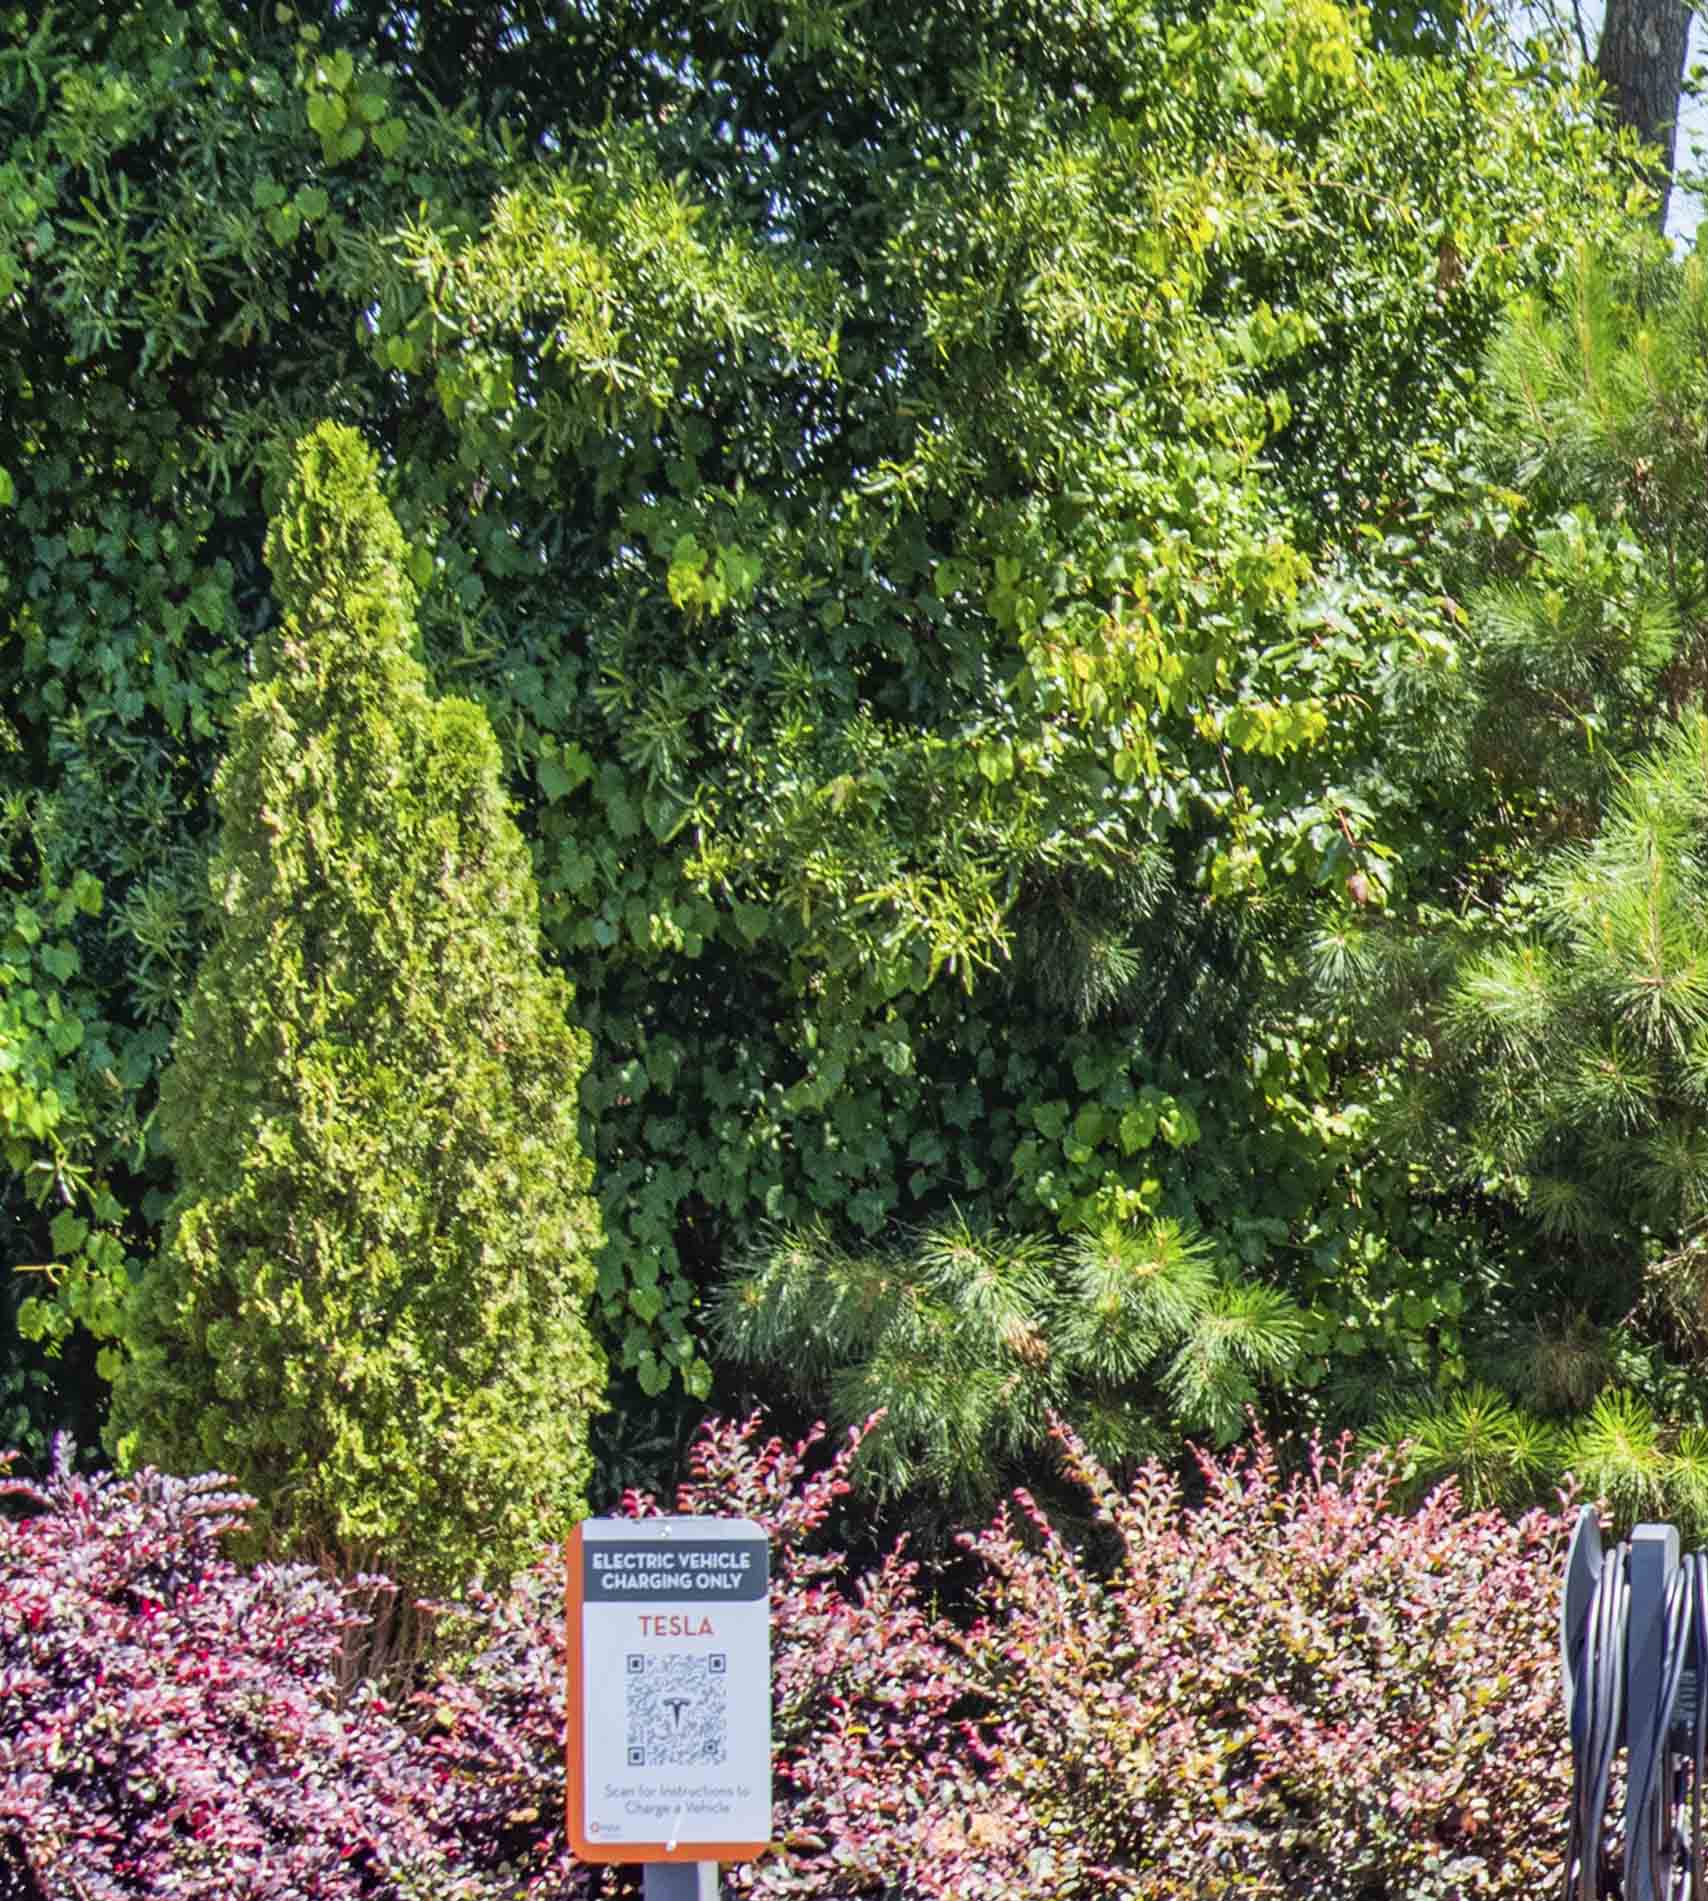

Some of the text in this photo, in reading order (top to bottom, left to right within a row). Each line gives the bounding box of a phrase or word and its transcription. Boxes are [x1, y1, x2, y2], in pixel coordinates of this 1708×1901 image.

[592, 1552, 751, 1570] ELECTRIC VEHICLE
[602, 1573, 742, 1589] CHARGING ONLY
[639, 1615, 714, 1636] TESLA
[605, 1784, 751, 1798] Scan for Instructions to
[625, 1800, 731, 1818] Charge a Vehicle
